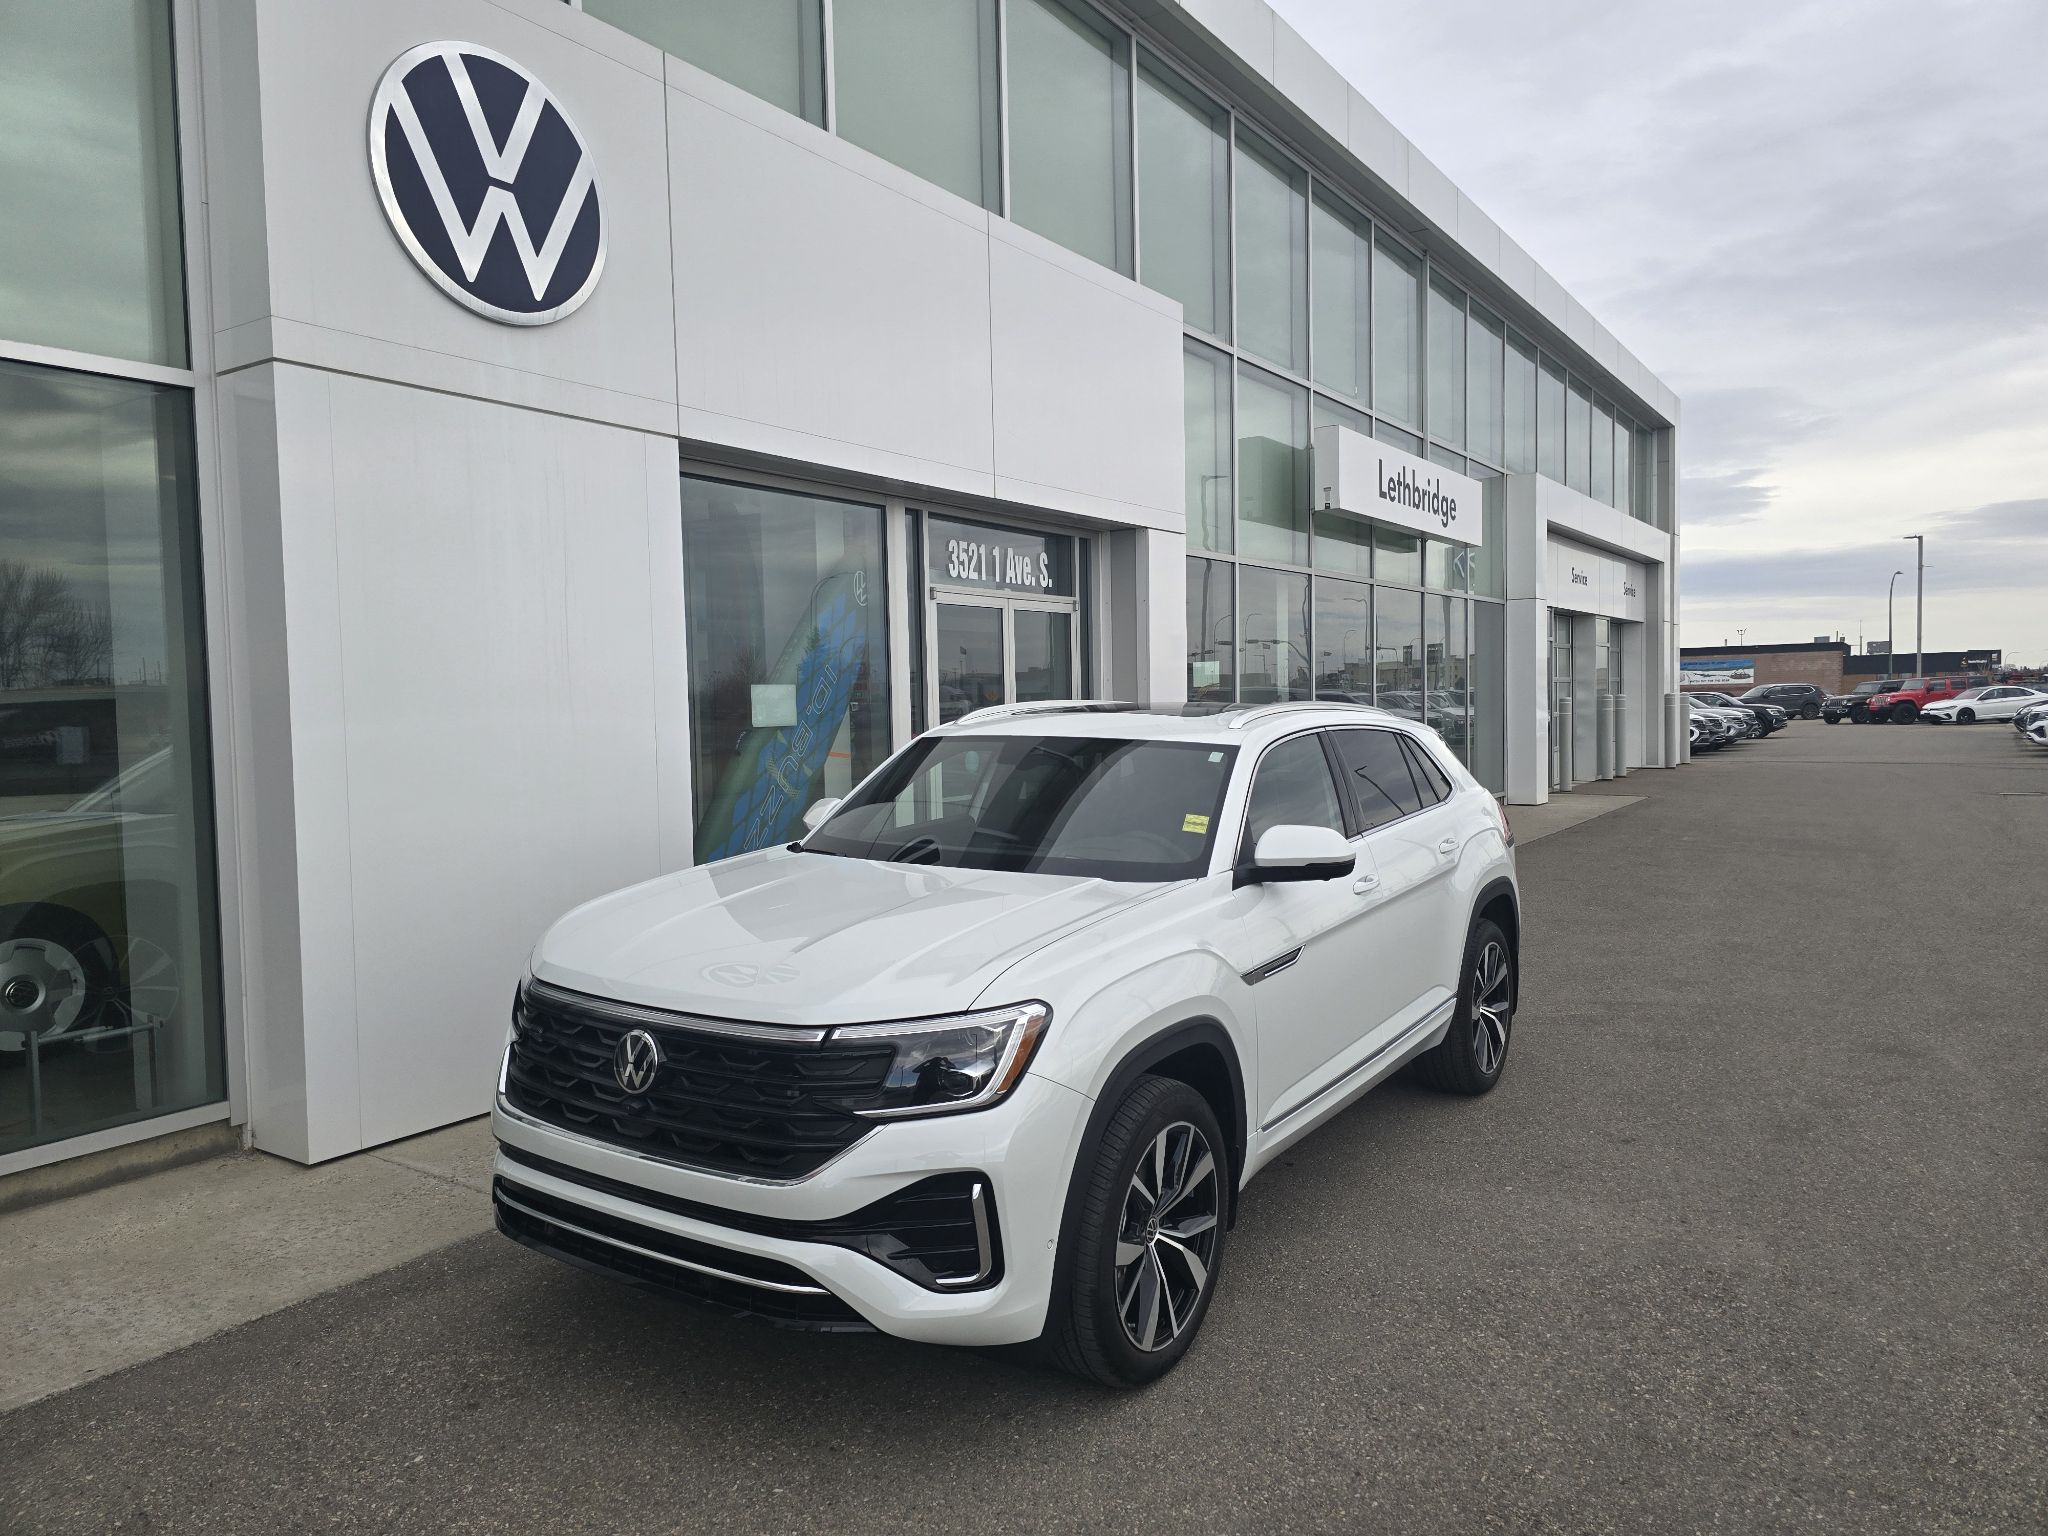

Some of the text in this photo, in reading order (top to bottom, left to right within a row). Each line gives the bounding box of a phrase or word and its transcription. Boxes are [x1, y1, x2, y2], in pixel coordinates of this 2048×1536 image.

[386, 48, 602, 302] VW
[1378, 458, 1457, 528] Lethbridge
[948, 539, 1053, 588] 3521 1 Ave. S.
[1571, 566, 1588, 587] Service
[616, 1030, 656, 1090] VW
